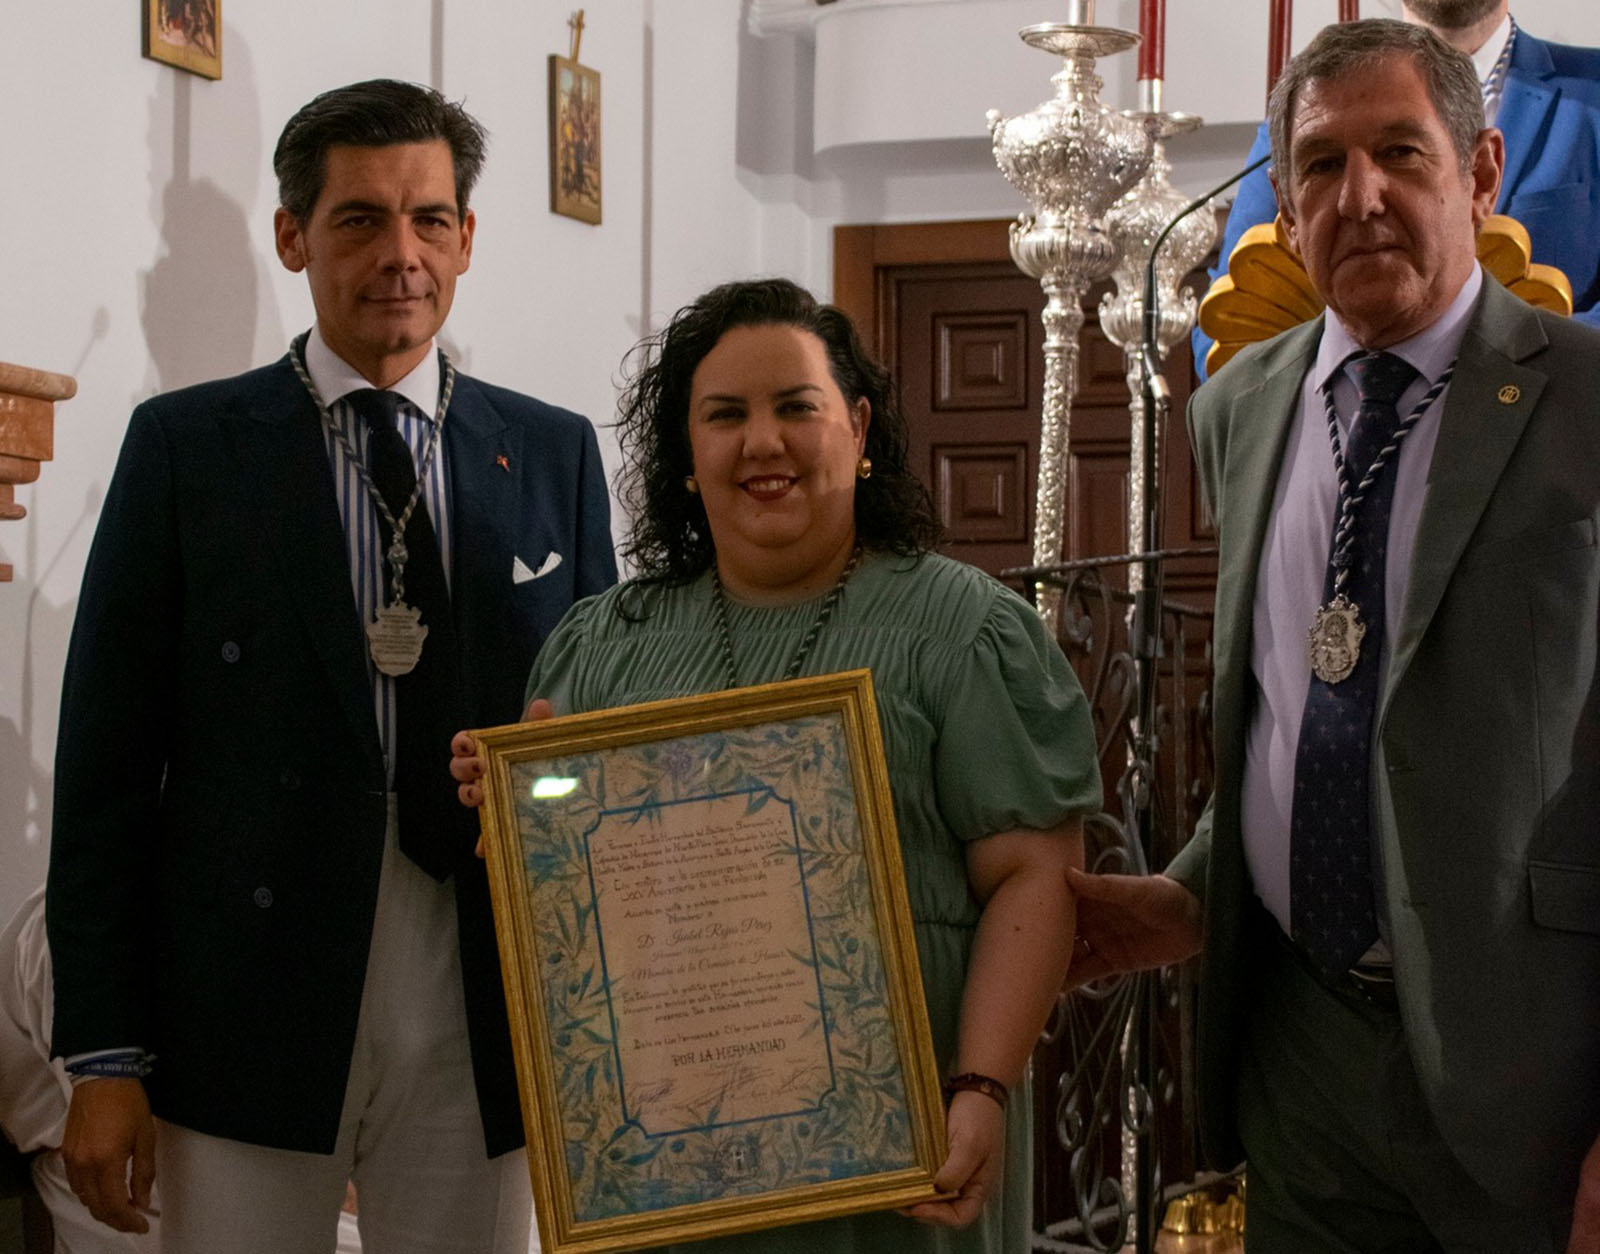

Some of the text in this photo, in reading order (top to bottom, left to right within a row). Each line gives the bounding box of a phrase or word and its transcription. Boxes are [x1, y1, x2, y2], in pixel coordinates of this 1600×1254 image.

[671, 1051, 695, 1067] POR
[698, 1048, 713, 1062] LA
[715, 1037, 786, 1060] HERMANDAD
